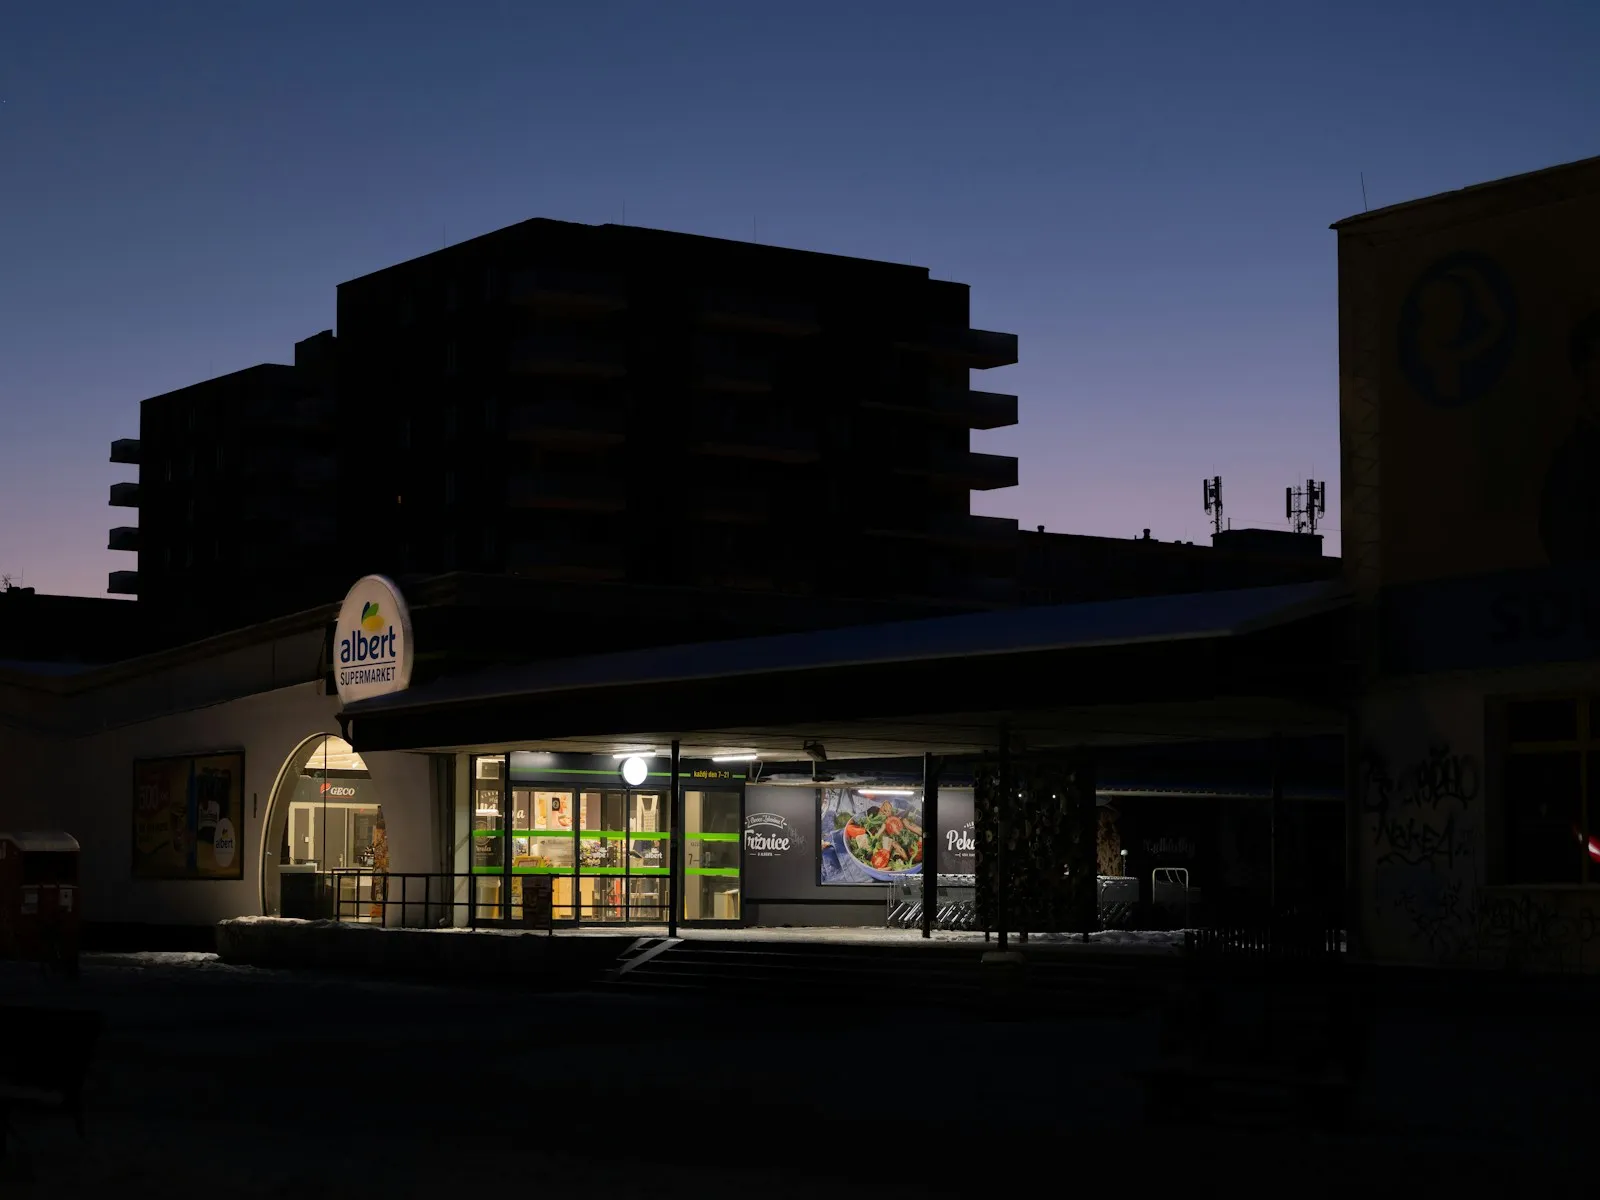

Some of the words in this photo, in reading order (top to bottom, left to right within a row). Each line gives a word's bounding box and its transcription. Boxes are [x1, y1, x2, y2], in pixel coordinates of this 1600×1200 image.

[340, 625, 396, 663] albert
[340, 666, 396, 686] SUPERMARKET
[330, 787, 355, 796] GECO
[215, 838, 234, 849] albert
